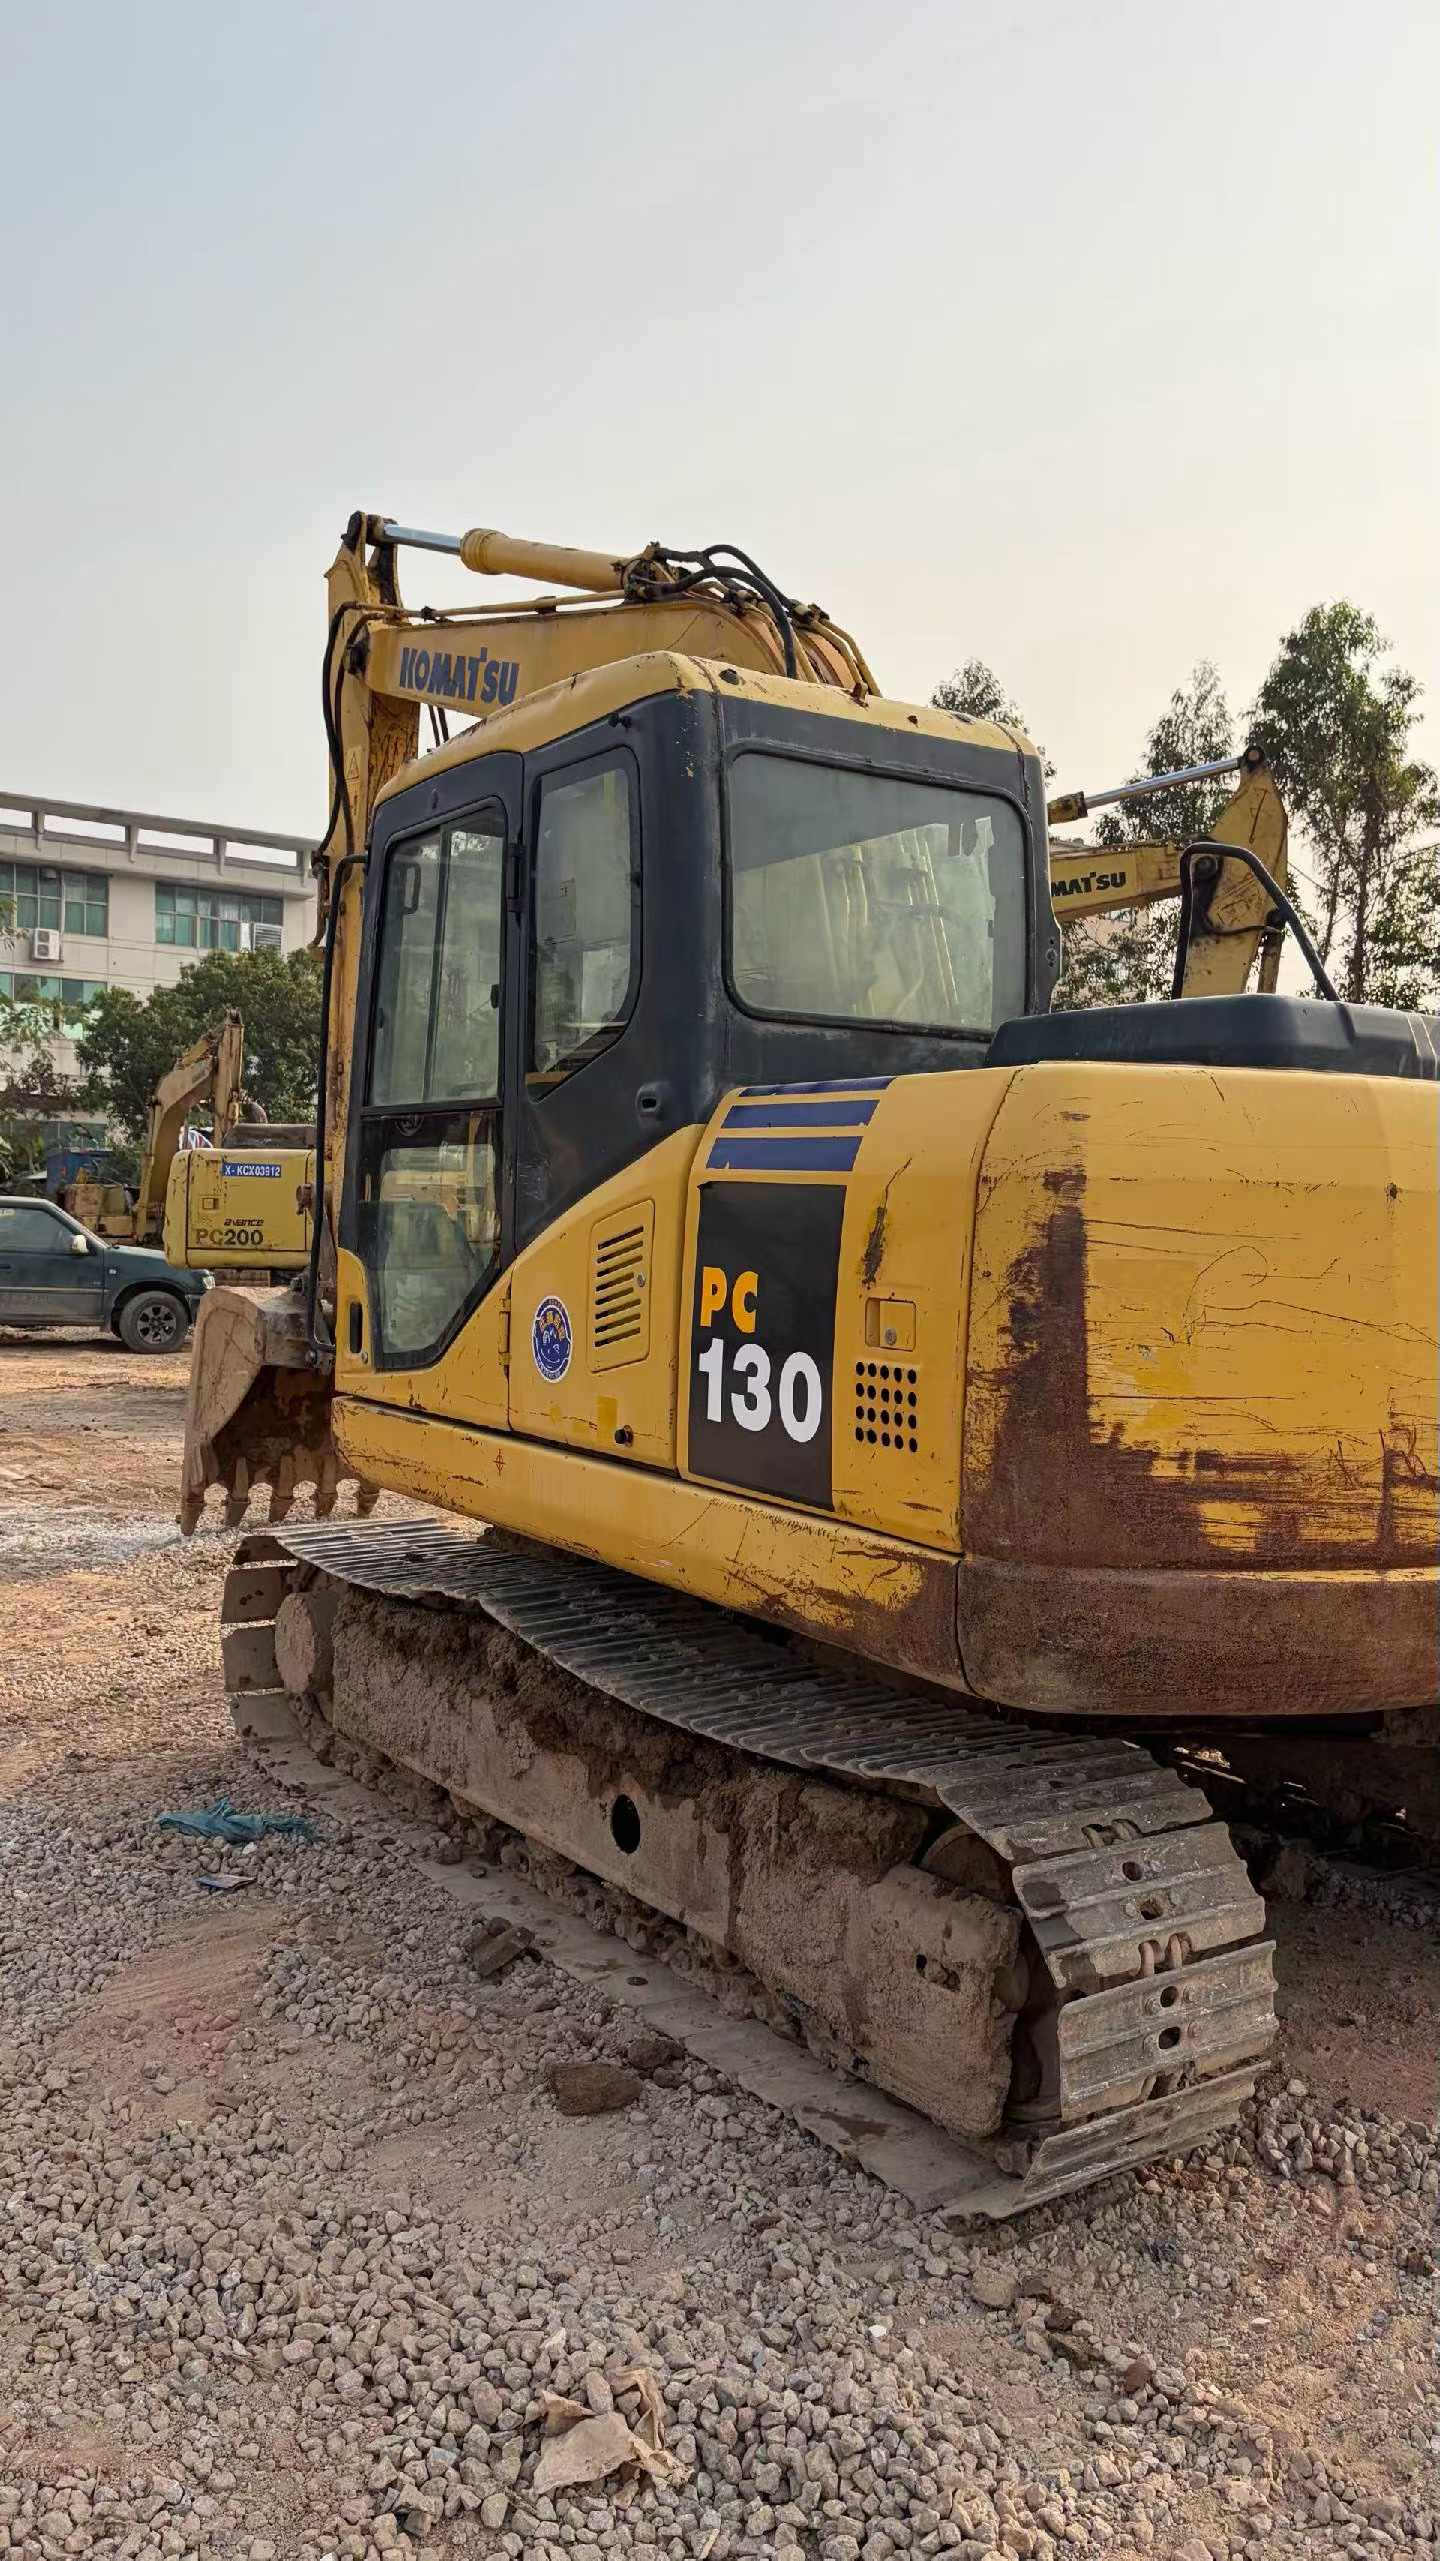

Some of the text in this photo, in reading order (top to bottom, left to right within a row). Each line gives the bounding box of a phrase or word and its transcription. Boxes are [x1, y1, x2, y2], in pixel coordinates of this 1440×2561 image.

[399, 646, 520, 706] KOMATSU
[195, 1228, 264, 1246] PC200
[700, 1265, 759, 1334] PC
[698, 1337, 823, 1443] 130
